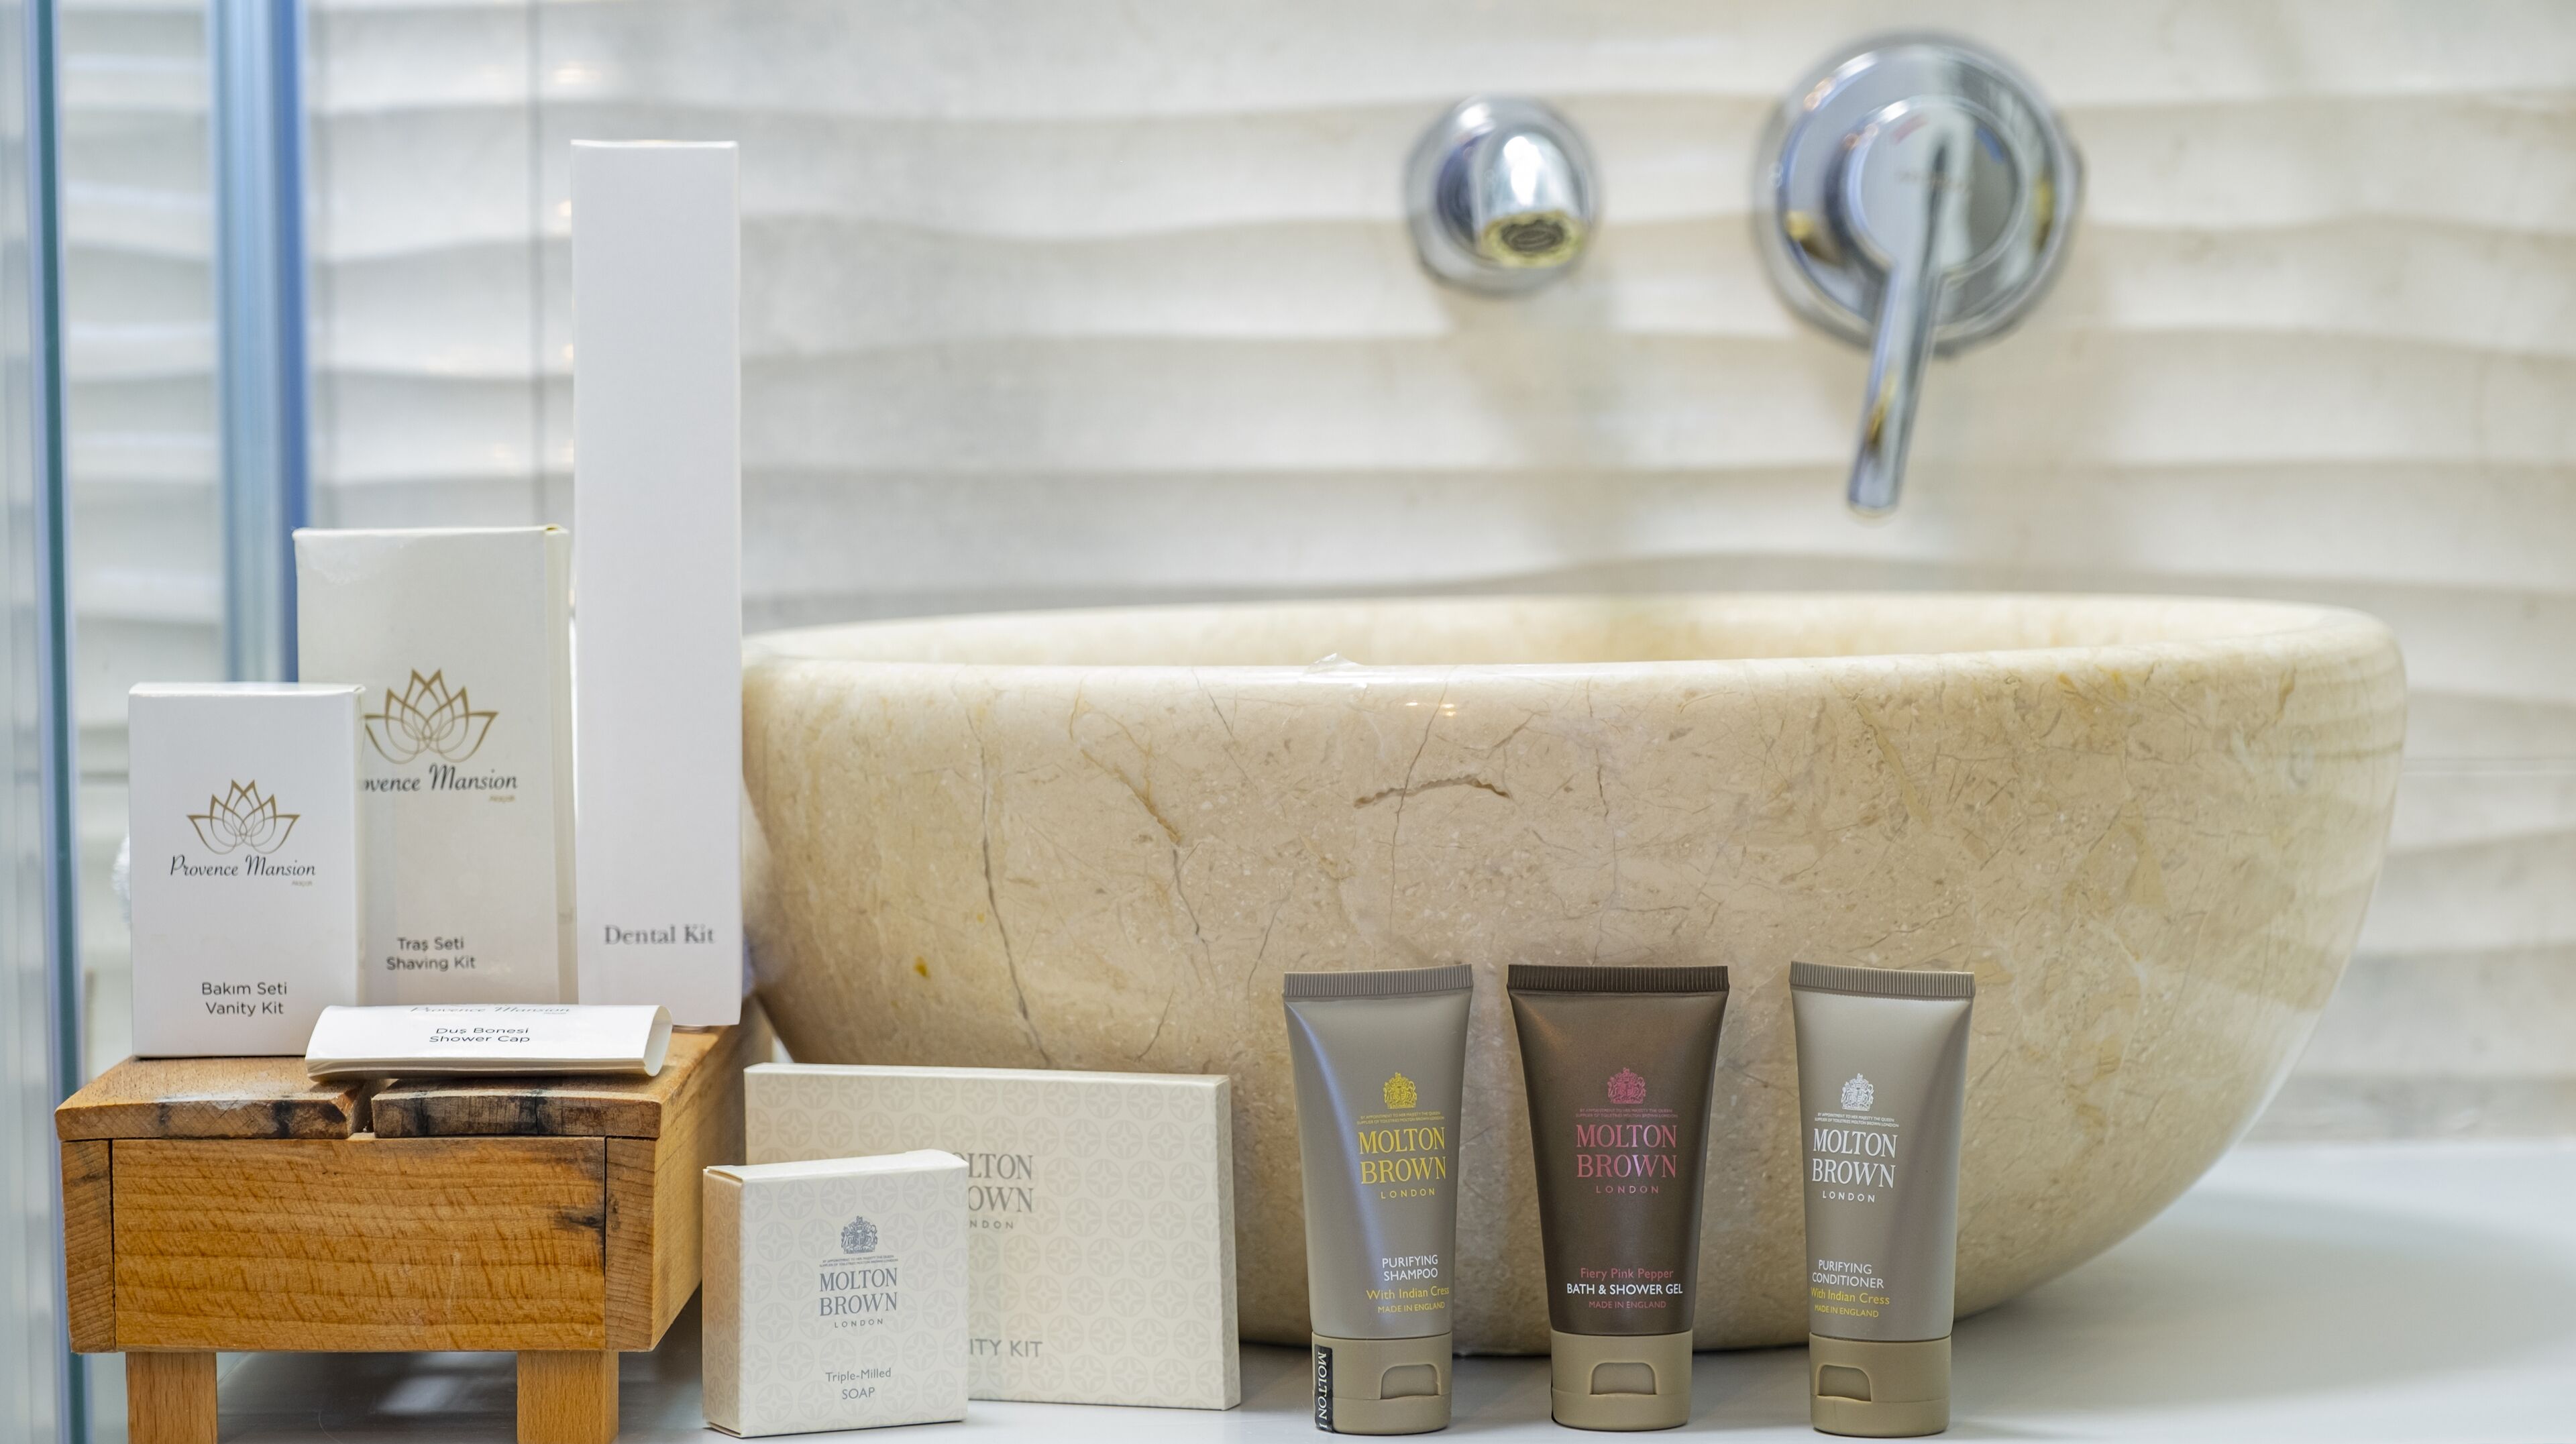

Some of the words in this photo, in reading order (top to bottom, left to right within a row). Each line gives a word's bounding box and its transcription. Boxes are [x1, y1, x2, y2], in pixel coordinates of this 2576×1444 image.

[364, 778, 421, 792] ovence
[429, 763, 518, 791] Mansion
[170, 854, 238, 877] Provence
[245, 854, 317, 877] Mansion
[604, 924, 676, 944] Dental
[684, 924, 716, 944] Kit
[397, 937, 429, 952] Traş
[434, 936, 464, 950] Seti
[386, 956, 449, 972] Shaving
[454, 955, 476, 969] Kit
[202, 981, 251, 995] Bakım
[257, 981, 287, 995] Seti
[205, 1001, 256, 1017] Vanity
[262, 1001, 284, 1014] Kit
[1358, 1127, 1444, 1154] MOLTON
[1576, 1124, 1677, 1148] MOLTON
[1813, 1128, 1898, 1158] MOLTON
[953, 1152, 1034, 1180] LTON
[1360, 1156, 1446, 1184] BROWN
[1576, 1154, 1677, 1178] BROWN
[1812, 1158, 1896, 1188] BROWN
[1381, 1188, 1435, 1199] LONDON
[1596, 1185, 1659, 1194] LONDON
[1823, 1190, 1875, 1203] LONDON
[968, 1185, 1034, 1213] OWN
[969, 1220, 1014, 1229] NDON
[1382, 1254, 1438, 1268] PURIFYING
[1819, 1260, 1872, 1274] PURIFYING
[820, 1268, 897, 1292] MOLTON
[1384, 1268, 1438, 1281] SHAMPOO
[1580, 1268, 1607, 1281] Fiery
[1611, 1268, 1634, 1278] Pink
[1638, 1268, 1674, 1281] Pepper
[1812, 1272, 1884, 1288] CONDITIONER
[1366, 1289, 1395, 1300] With
[1399, 1287, 1428, 1299] Indian
[1566, 1283, 1595, 1294] BATH
[1598, 1284, 1607, 1294] &
[1610, 1284, 1663, 1294] SHOWER
[1666, 1284, 1682, 1294] GEL
[820, 1292, 897, 1316] BROWN
[1828, 1289, 1856, 1302] Indian
[1860, 1292, 1890, 1305] Cress
[1378, 1305, 1402, 1313] MADE
[1415, 1302, 1445, 1311] ENGLAND
[1830, 1306, 1838, 1314] IN
[1839, 1307, 1879, 1318] ENGLAND
[834, 1319, 883, 1329] LONDON
[969, 1339, 1002, 1356] ITY
[1010, 1341, 1043, 1357] KIT
[825, 1368, 891, 1384] Triple-Milled
[842, 1387, 875, 1400] SOAP
[1318, 1351, 1328, 1420] MOLTON
